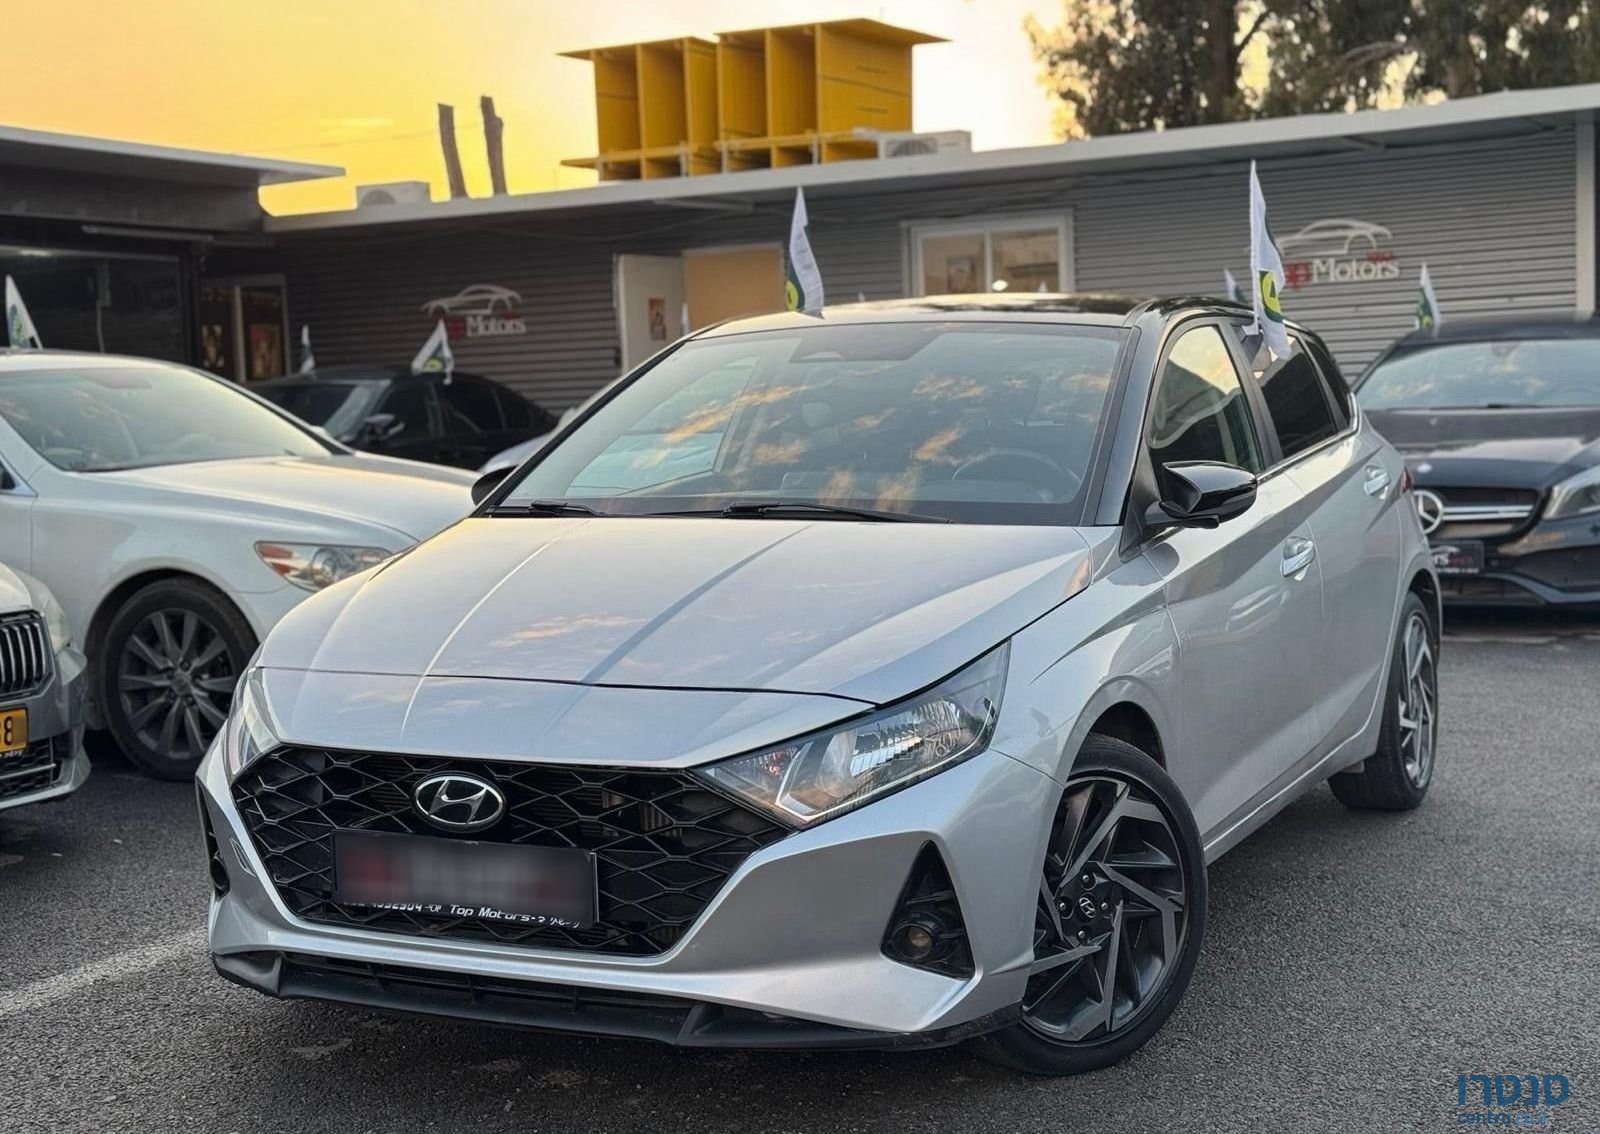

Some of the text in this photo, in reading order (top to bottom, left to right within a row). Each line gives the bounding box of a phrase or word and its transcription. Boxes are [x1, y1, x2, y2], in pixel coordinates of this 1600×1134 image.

[1312, 257, 1400, 283] Motors
[0, 715, 14, 746] 8
[449, 904, 474, 918] Top
